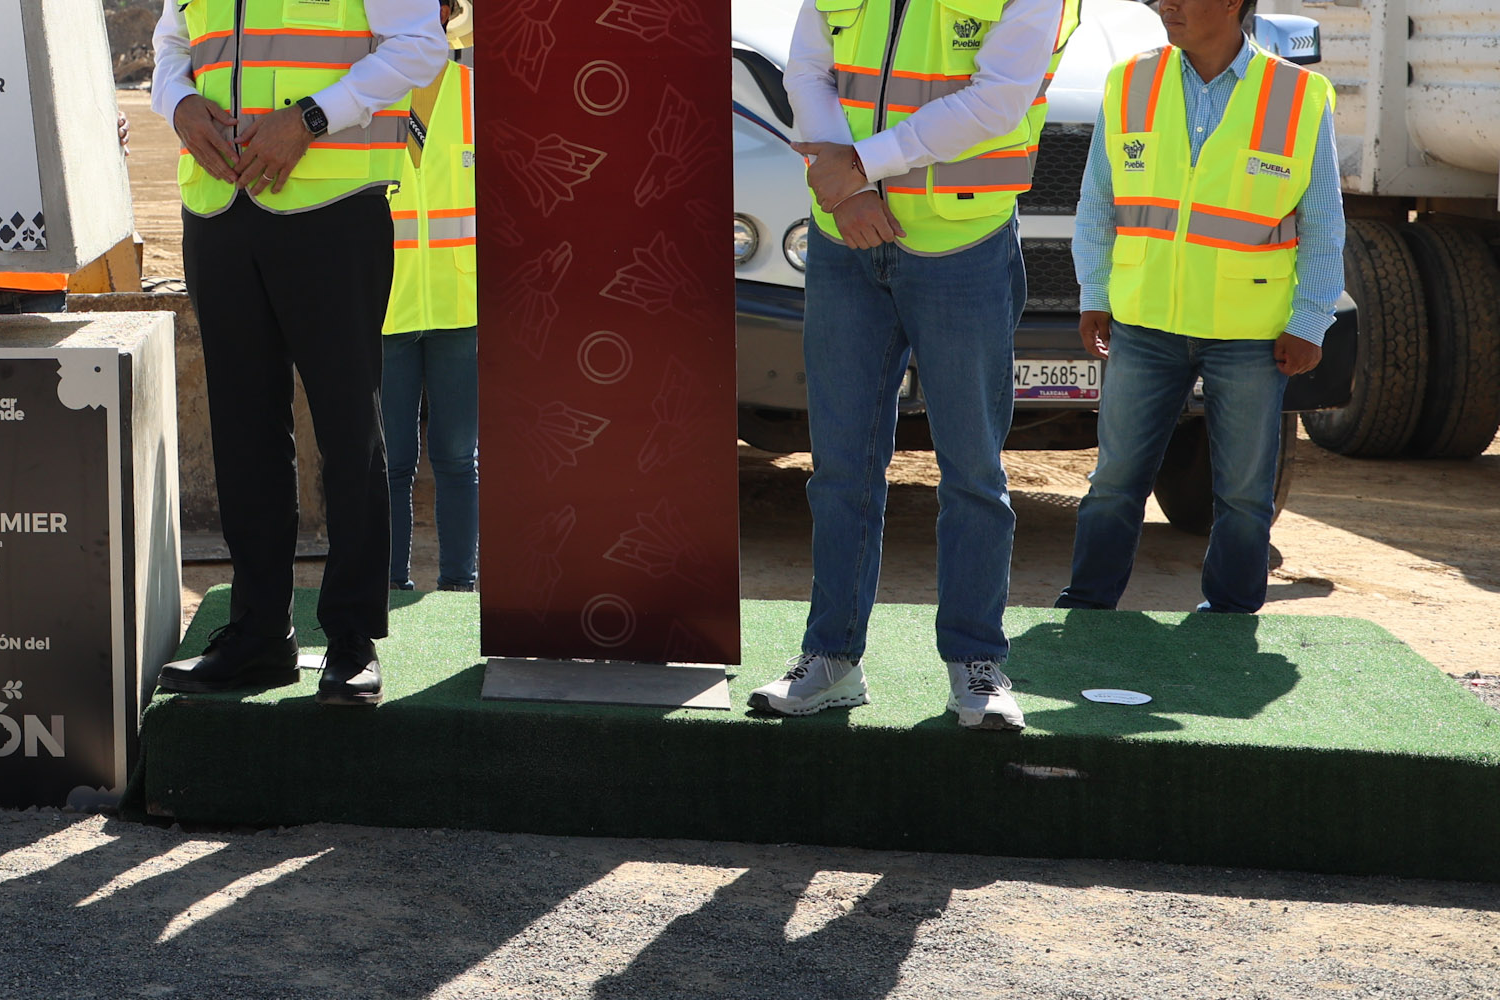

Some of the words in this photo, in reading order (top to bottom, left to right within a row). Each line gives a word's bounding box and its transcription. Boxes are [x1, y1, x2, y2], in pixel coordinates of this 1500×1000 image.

[952, 39, 980, 48] Puebla
[1260, 162, 1291, 174] PUEBLA
[0, 513, 68, 533] MIER
[24, 636, 50, 650] del
